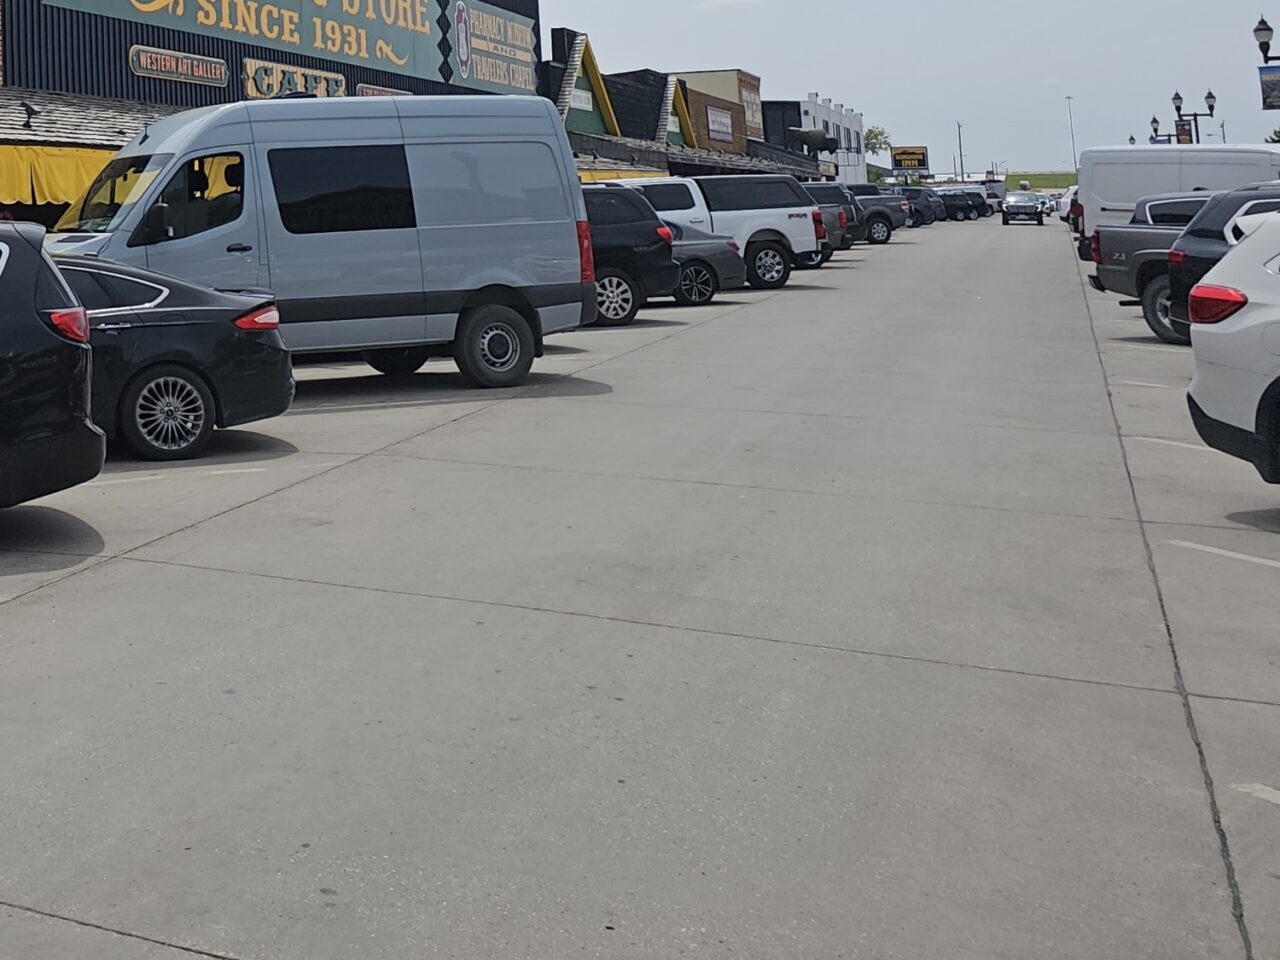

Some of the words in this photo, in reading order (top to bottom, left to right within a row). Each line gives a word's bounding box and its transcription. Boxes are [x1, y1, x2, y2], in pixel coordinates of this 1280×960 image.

[312, 17, 369, 59] 1931
[469, 9, 505, 42] PHARMACY
[139, 51, 176, 74] WESTERN
[177, 58, 192, 75] ART
[193, 60, 225, 80] GALLERY
[493, 45, 517, 57] AND
[252, 66, 343, 97] CAFE
[471, 54, 508, 85] TRAVELERS
[901, 159, 919, 167] INN
